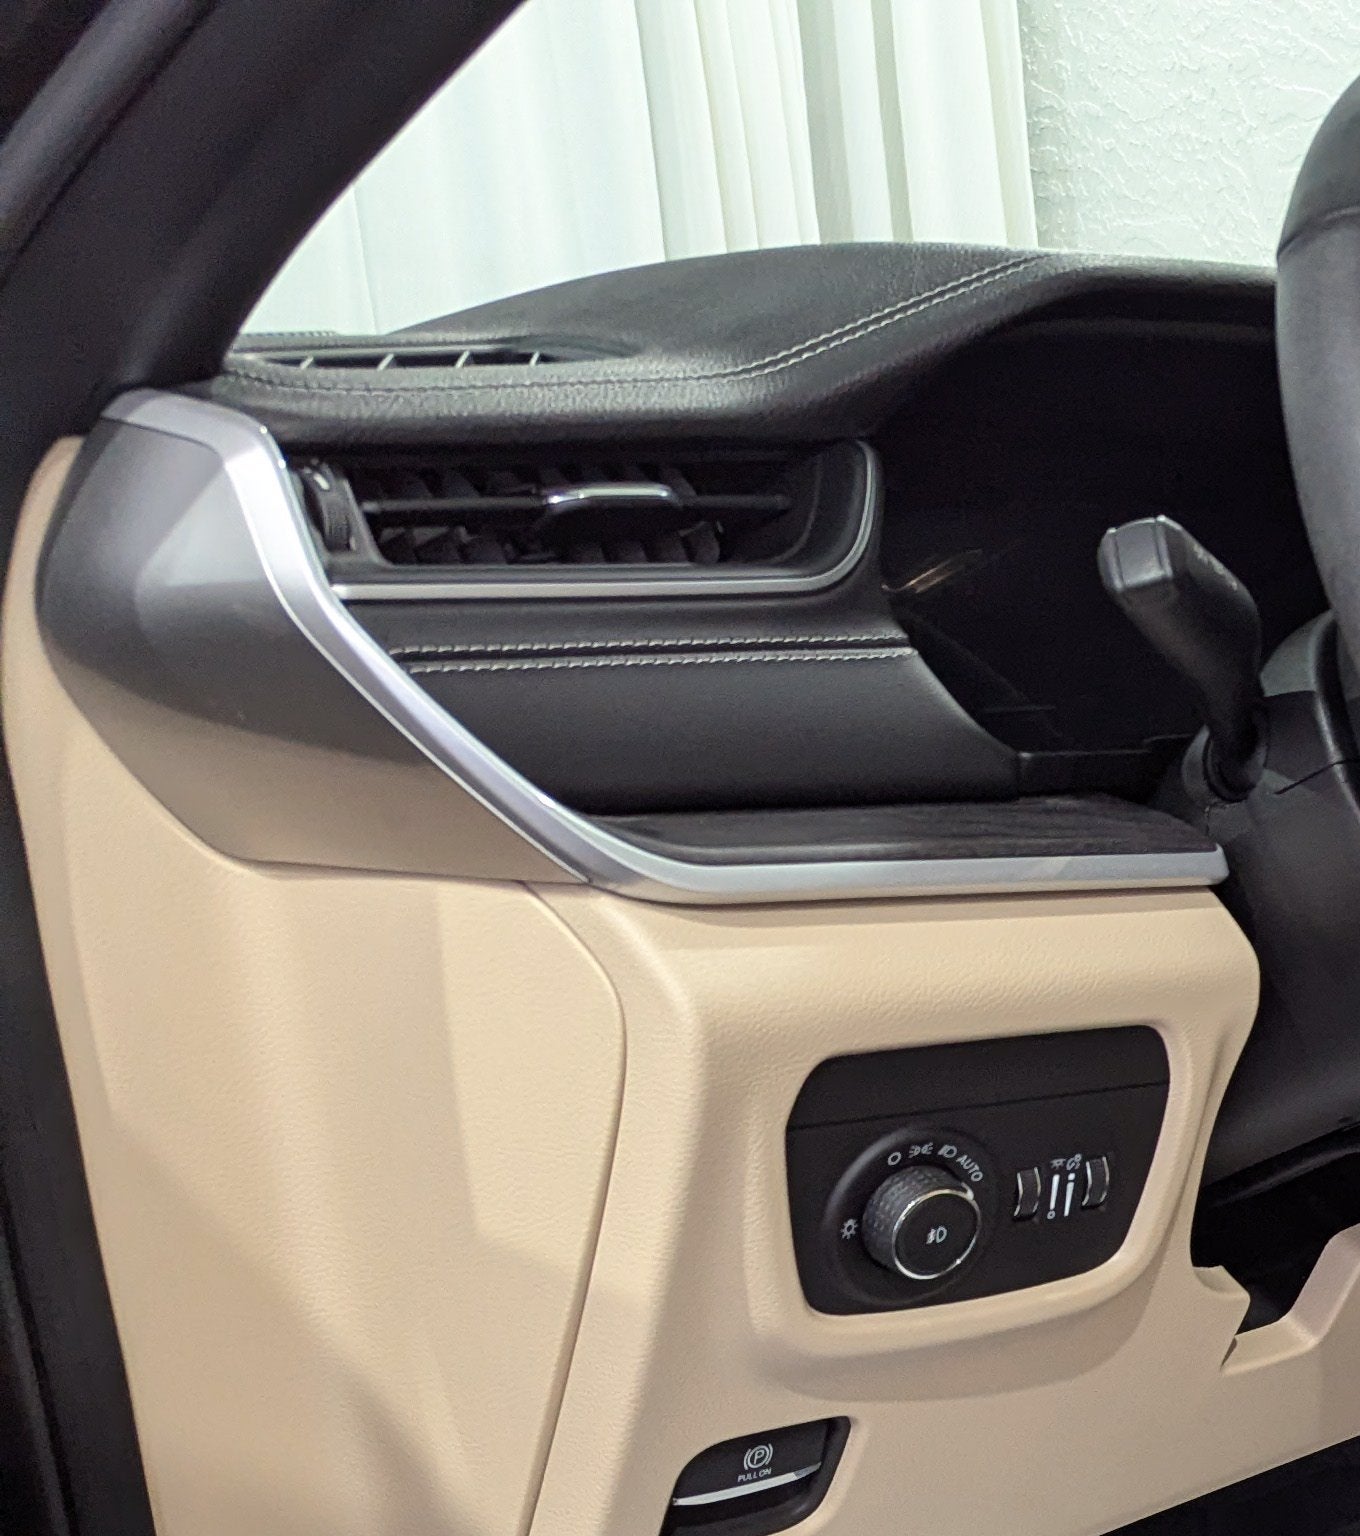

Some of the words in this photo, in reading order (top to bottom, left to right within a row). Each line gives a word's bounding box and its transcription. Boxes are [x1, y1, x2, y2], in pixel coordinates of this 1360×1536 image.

[956, 1154, 984, 1182] AUTO
[737, 1471, 758, 1483] PULL
[758, 1467, 772, 1478] ON
